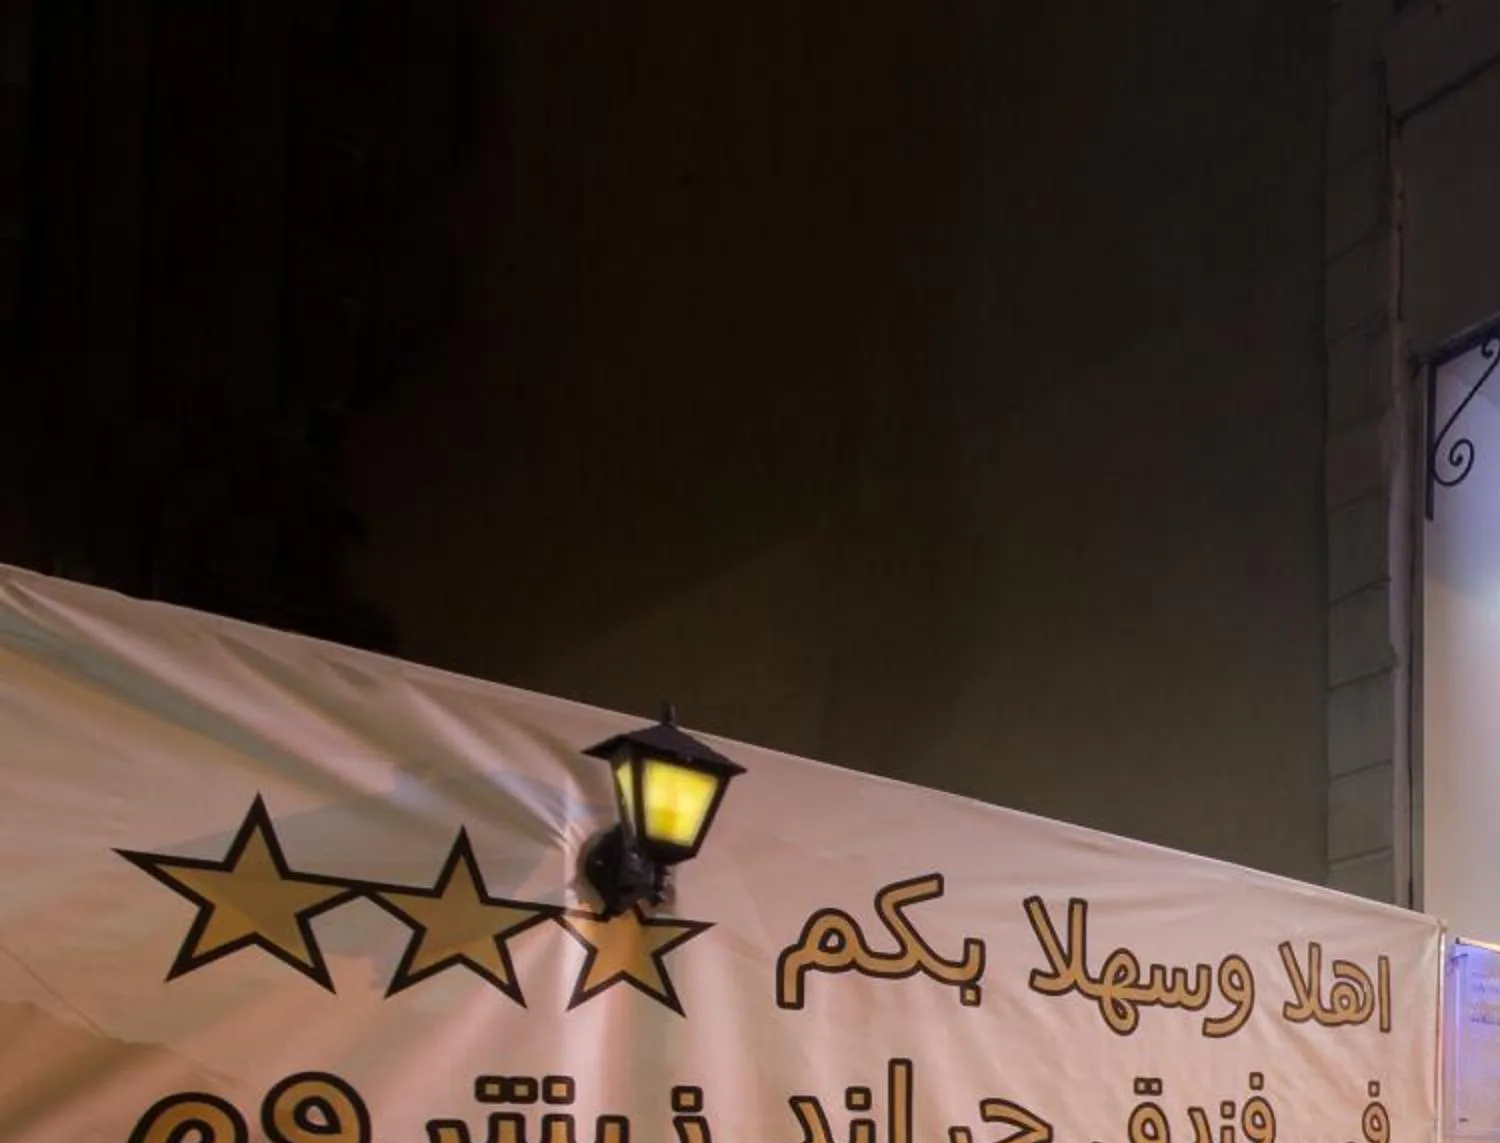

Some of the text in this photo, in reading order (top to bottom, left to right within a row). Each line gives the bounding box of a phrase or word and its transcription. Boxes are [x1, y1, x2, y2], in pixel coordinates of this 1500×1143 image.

[775, 872, 987, 1011] بكم
[1023, 895, 1256, 1038] وسهلا
[1277, 939, 1391, 1033] اهلا
